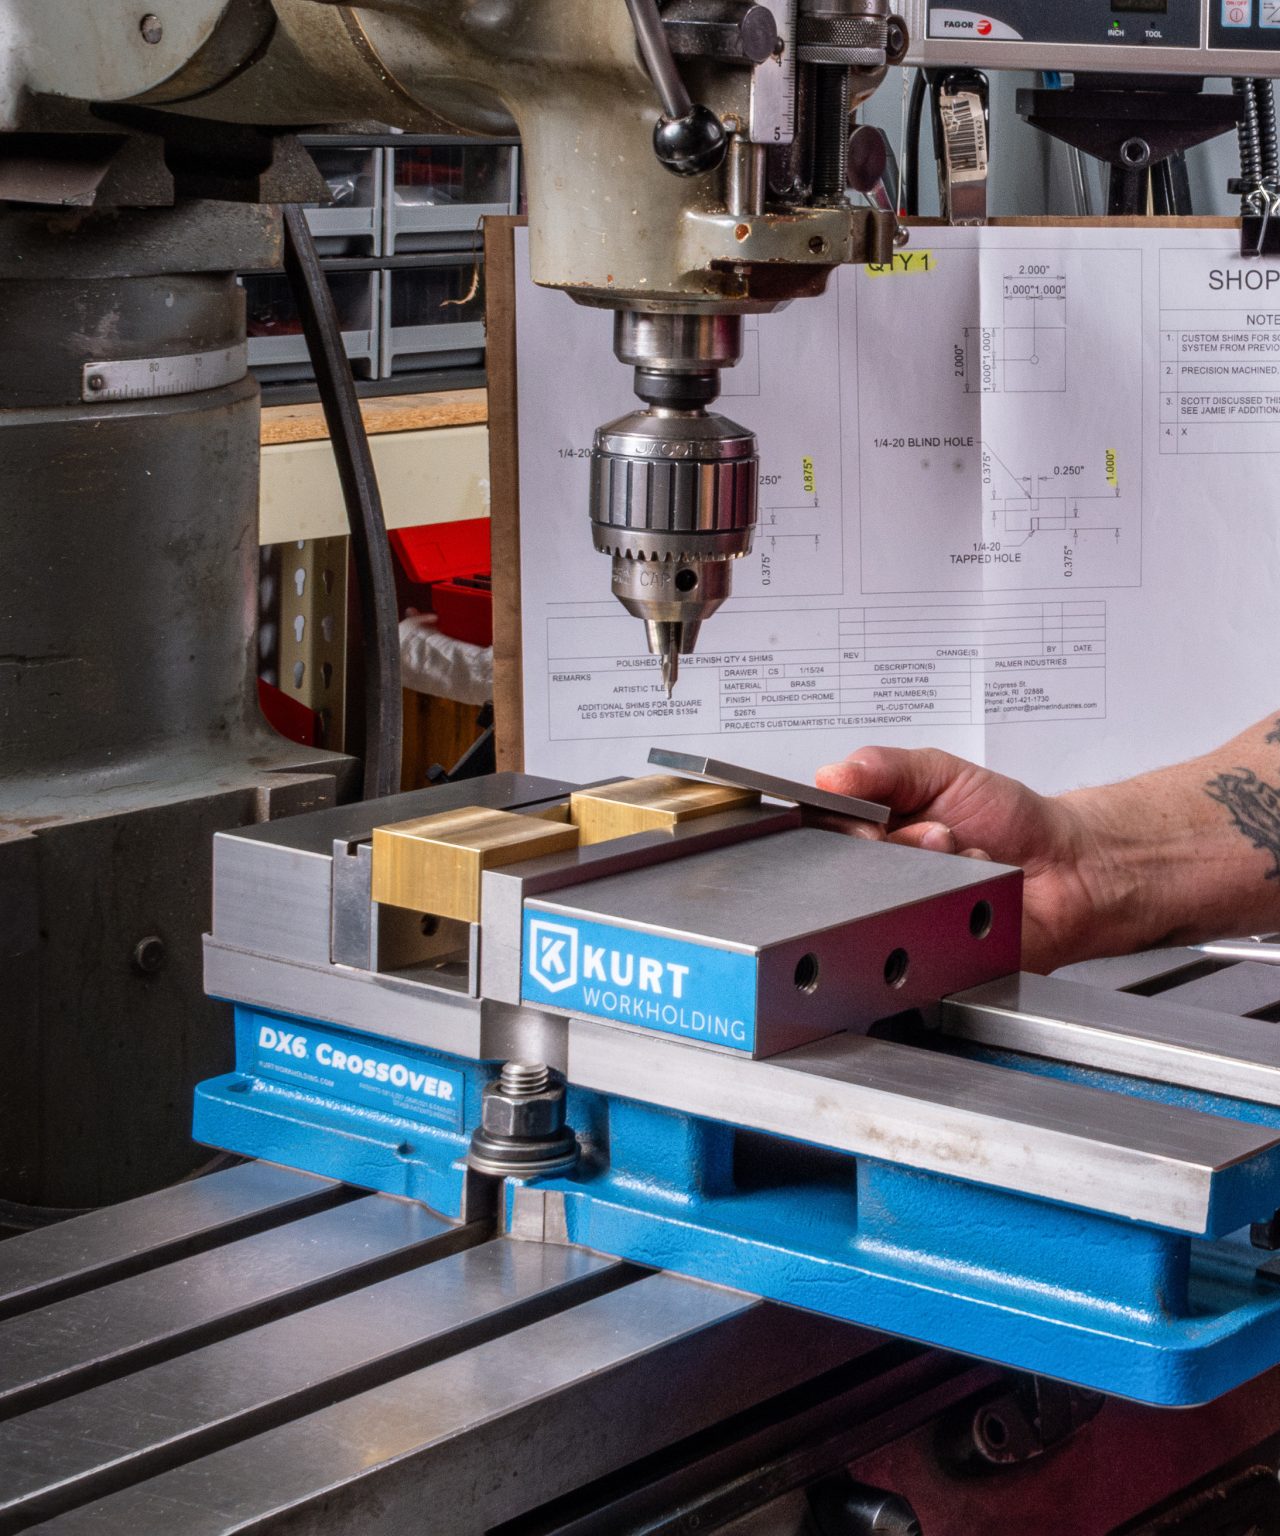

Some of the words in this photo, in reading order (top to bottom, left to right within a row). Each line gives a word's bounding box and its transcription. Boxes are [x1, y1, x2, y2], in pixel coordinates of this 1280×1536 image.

[944, 21, 974, 30] FAGOR
[1107, 29, 1125, 37] INCH
[1144, 30, 1162, 39] TOOL
[774, 126, 781, 141] 5
[921, 253, 929, 271] 1
[1018, 265, 1050, 275] 2.000"
[1208, 269, 1280, 290] SHOP
[1004, 285, 1035, 295] 1.000"
[1035, 285, 1066, 294] 1.000"
[1166, 334, 1175, 342] 1.
[1181, 334, 1219, 343] CUSTOM
[1222, 334, 1249, 342] SHIMS
[1251, 334, 1270, 342] FOR
[1181, 344, 1217, 352] SYSTEM
[1220, 344, 1245, 352] FROM
[954, 344, 964, 377] 2.000"
[149, 362, 159, 373] 80
[1166, 367, 1174, 375] 2.
[1181, 367, 1229, 375] PRECISION
[1231, 367, 1280, 376] MACHINED,
[1166, 397, 1173, 405] 3.
[1180, 397, 1210, 405] SCOTT
[1212, 397, 1263, 405] DISCUSSED
[1180, 407, 1198, 415] SEE
[1200, 407, 1226, 415] JAMIE
[1228, 406, 1236, 414] IF
[1181, 428, 1188, 436] X
[873, 438, 905, 448] 1/4-20
[907, 437, 940, 447] BLIND
[943, 437, 974, 447] HOLE
[558, 448, 591, 458] 1/4-20
[982, 451, 991, 484] 0.375"
[1105, 449, 1115, 481] 1.000"
[803, 458, 813, 492] 0.875"
[1053, 465, 1085, 476] 0.250"
[973, 542, 1001, 551] 1/4-20
[950, 554, 992, 564] TAPPED
[994, 553, 1022, 563] HOLE
[1064, 545, 1073, 577] 0.375"
[761, 553, 771, 586] 0.375"
[1046, 645, 1057, 653] BY
[1073, 644, 1093, 652] DATE
[936, 649, 979, 657] CHANGE(S)
[616, 659, 657, 668] POLISHED
[696, 655, 722, 664] FINISH
[724, 655, 741, 663] QTY
[749, 654, 774, 662] SHIMS
[995, 660, 1022, 668] PALMER
[1023, 658, 1067, 667] INDUSTRIES
[768, 667, 779, 675] CS
[874, 662, 936, 672] DESCRIPTION(S)
[724, 669, 758, 677] DRAWER
[552, 674, 591, 682] REMARKS
[880, 676, 913, 685] CUSTOM
[915, 676, 929, 684] FAB
[724, 682, 762, 690] MATERIAL
[790, 680, 816, 688] BRASS
[992, 682, 1018, 691] Cypress
[613, 685, 648, 694] ARTISTIC
[873, 690, 892, 698] PART
[894, 689, 937, 698] NUMBER(S)
[725, 696, 751, 704] FINISH
[761, 694, 799, 702] POLISHED
[801, 693, 834, 701] CHROME
[577, 703, 624, 711] ADDITIONAL
[626, 702, 650, 710] SHIMS
[652, 701, 668, 709] FOR
[669, 700, 702, 708] SQUARE
[876, 702, 934, 711] PL-CUSTOMFAB
[581, 712, 597, 720] LEG
[599, 711, 631, 719] SYSTEM
[633, 710, 645, 718] ON
[649, 709, 674, 717] ORDER
[724, 721, 765, 730] PROJECTS
[583, 944, 689, 998] KURT
[583, 986, 746, 1041] WORKHOLDING
[258, 1026, 308, 1059] DX6
